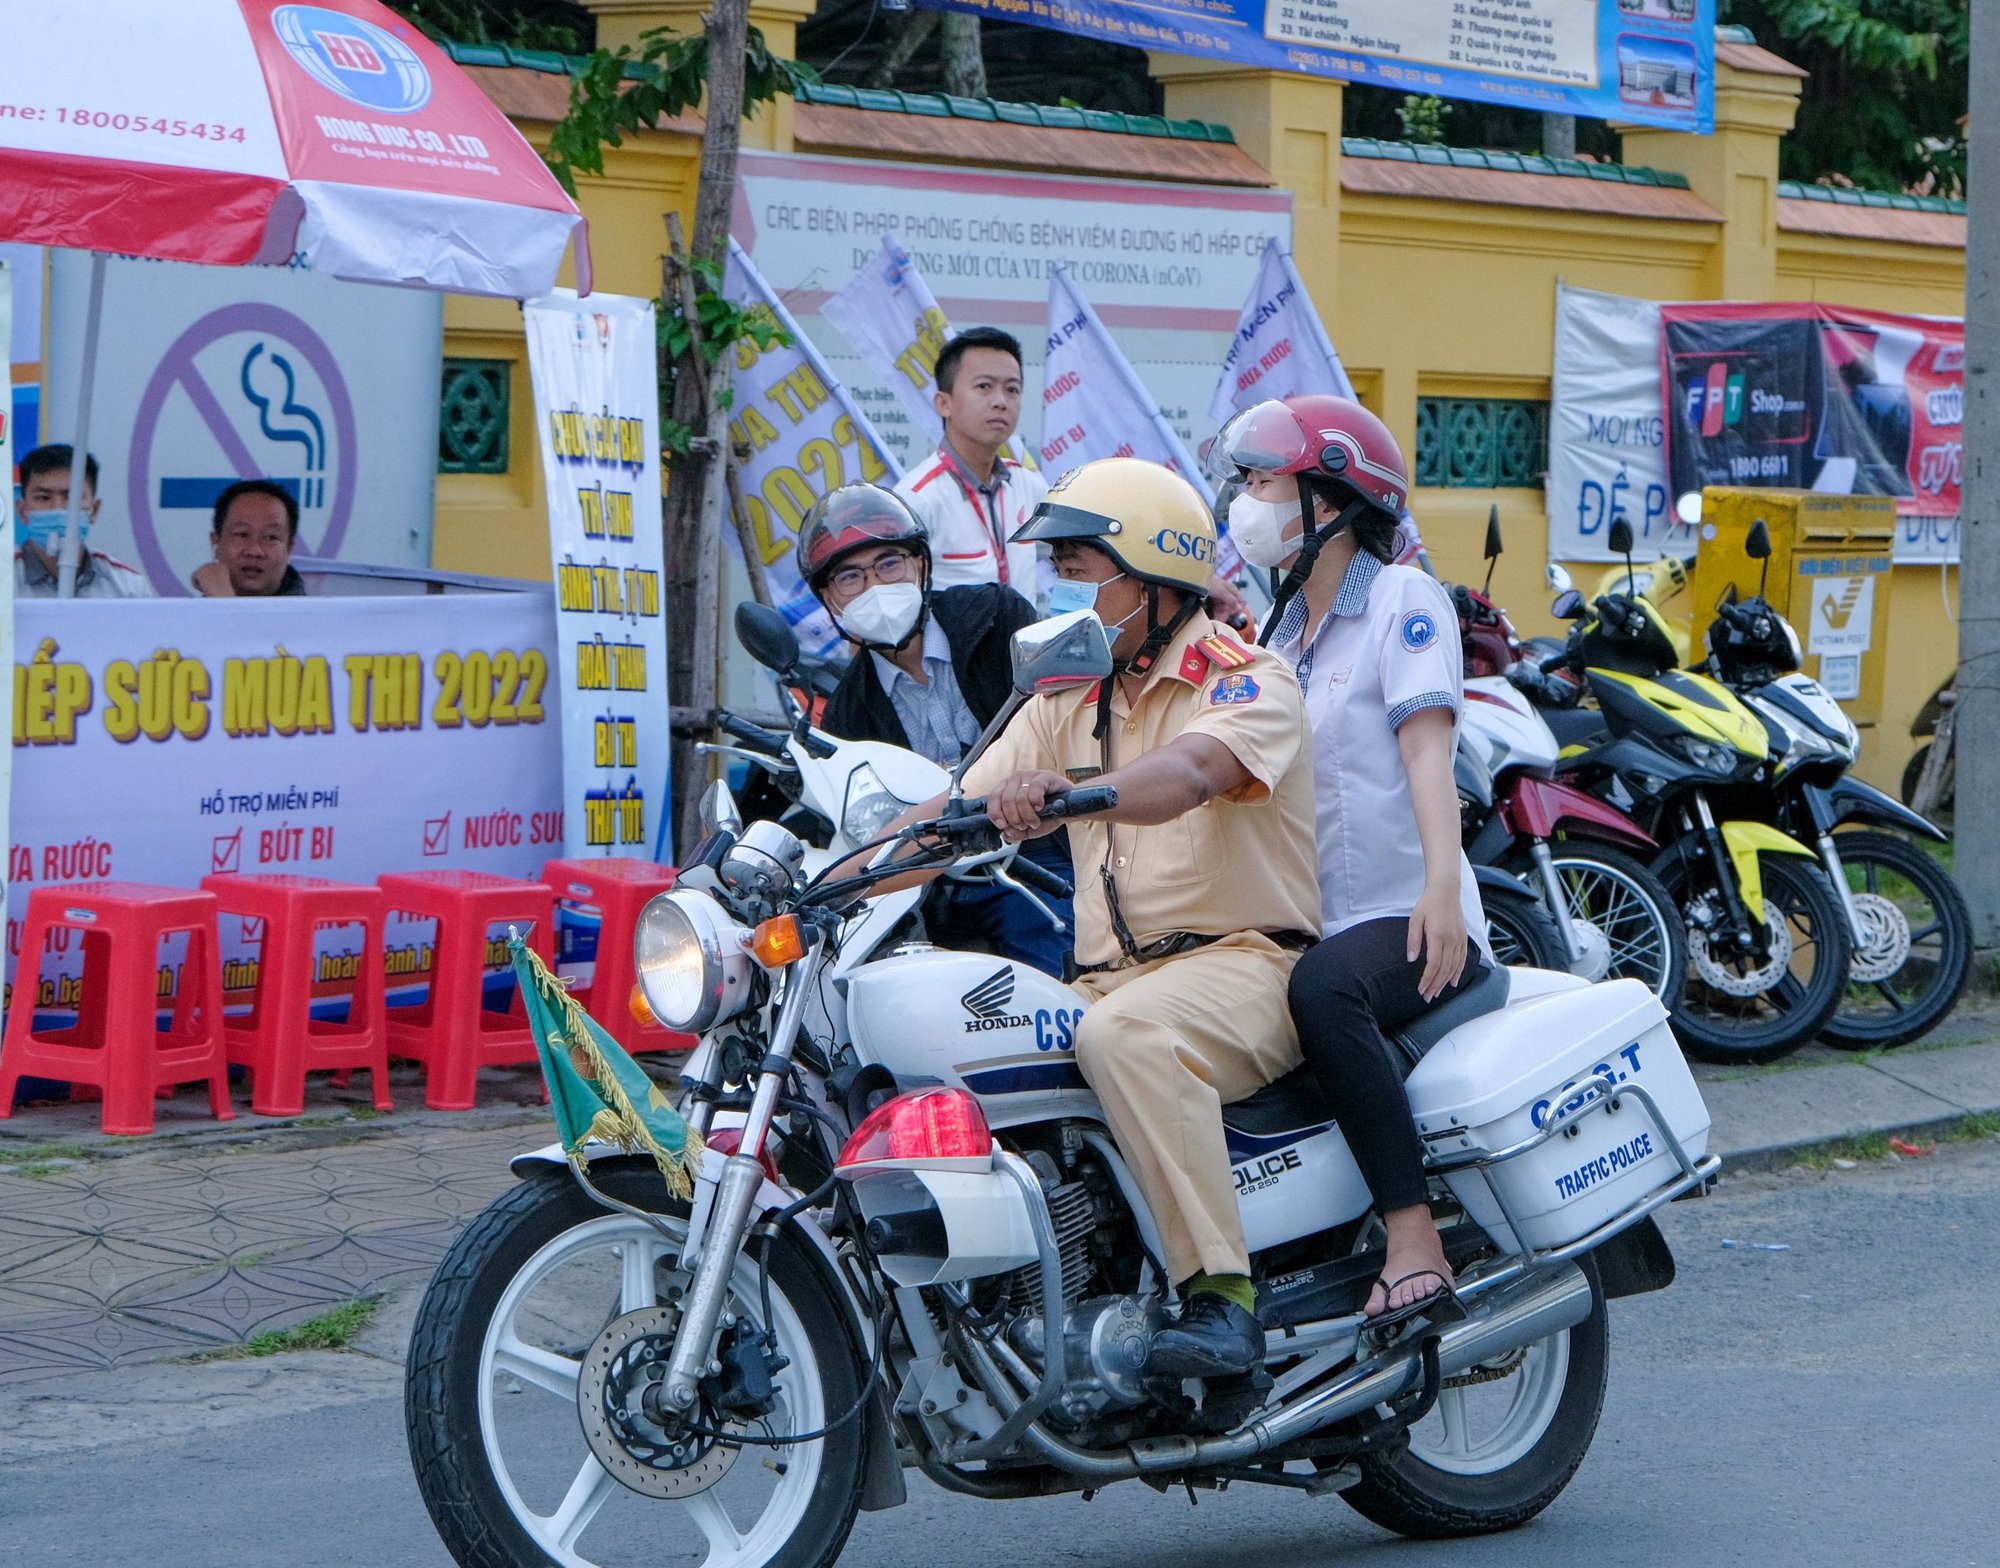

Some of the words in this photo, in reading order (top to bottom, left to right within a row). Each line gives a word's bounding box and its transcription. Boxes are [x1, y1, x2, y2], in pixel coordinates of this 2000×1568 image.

[1300, 10, 1349, 30] Marketing
[1470, 6, 1490, 17] Kinh
[1492, 9, 1519, 22] doanh
[1298, 25, 1312, 37] Tài
[1377, 38, 1400, 53] hàng
[1466, 53, 1502, 67] Logistics
[0, 104, 45, 121] ne:
[56, 107, 247, 144] 1800545434
[766, 202, 802, 231] CÁC
[1030, 219, 1073, 249] BỆNH
[947, 249, 982, 277] MỚI
[985, 250, 1023, 279] CỦA
[1023, 258, 1041, 280] VI
[1081, 260, 1150, 285] CORONA
[1152, 265, 1202, 290] (nCoV)
[765, 362, 827, 425] TH
[1686, 386, 1742, 412] FPT
[1156, 528, 1216, 565] CSGT
[12, 637, 93, 747] IẾP
[103, 647, 212, 744] SỨC
[222, 644, 335, 739] MÙA
[344, 652, 425, 733] THI
[432, 648, 549, 729] 2022
[200, 789, 224, 815] HỖ
[228, 792, 263, 817] TRỢ
[266, 785, 307, 812] MIỄN
[311, 786, 340, 809] PHÍ
[259, 821, 304, 864] BÚT
[310, 826, 334, 861] BI
[464, 807, 523, 850] NƯỚC
[528, 811, 565, 847] SU
[42, 835, 113, 881] RƯỚC
[964, 1014, 1034, 1034] HONDA
[1035, 1008, 1084, 1052] CS
[1232, 1149, 1303, 1190] OLICE
[1554, 1155, 1611, 1200] TRAFFIC
[1611, 1132, 1653, 1173] POLICE
[1240, 1184, 1257, 1197] CB
[1258, 1176, 1280, 1191] 250
